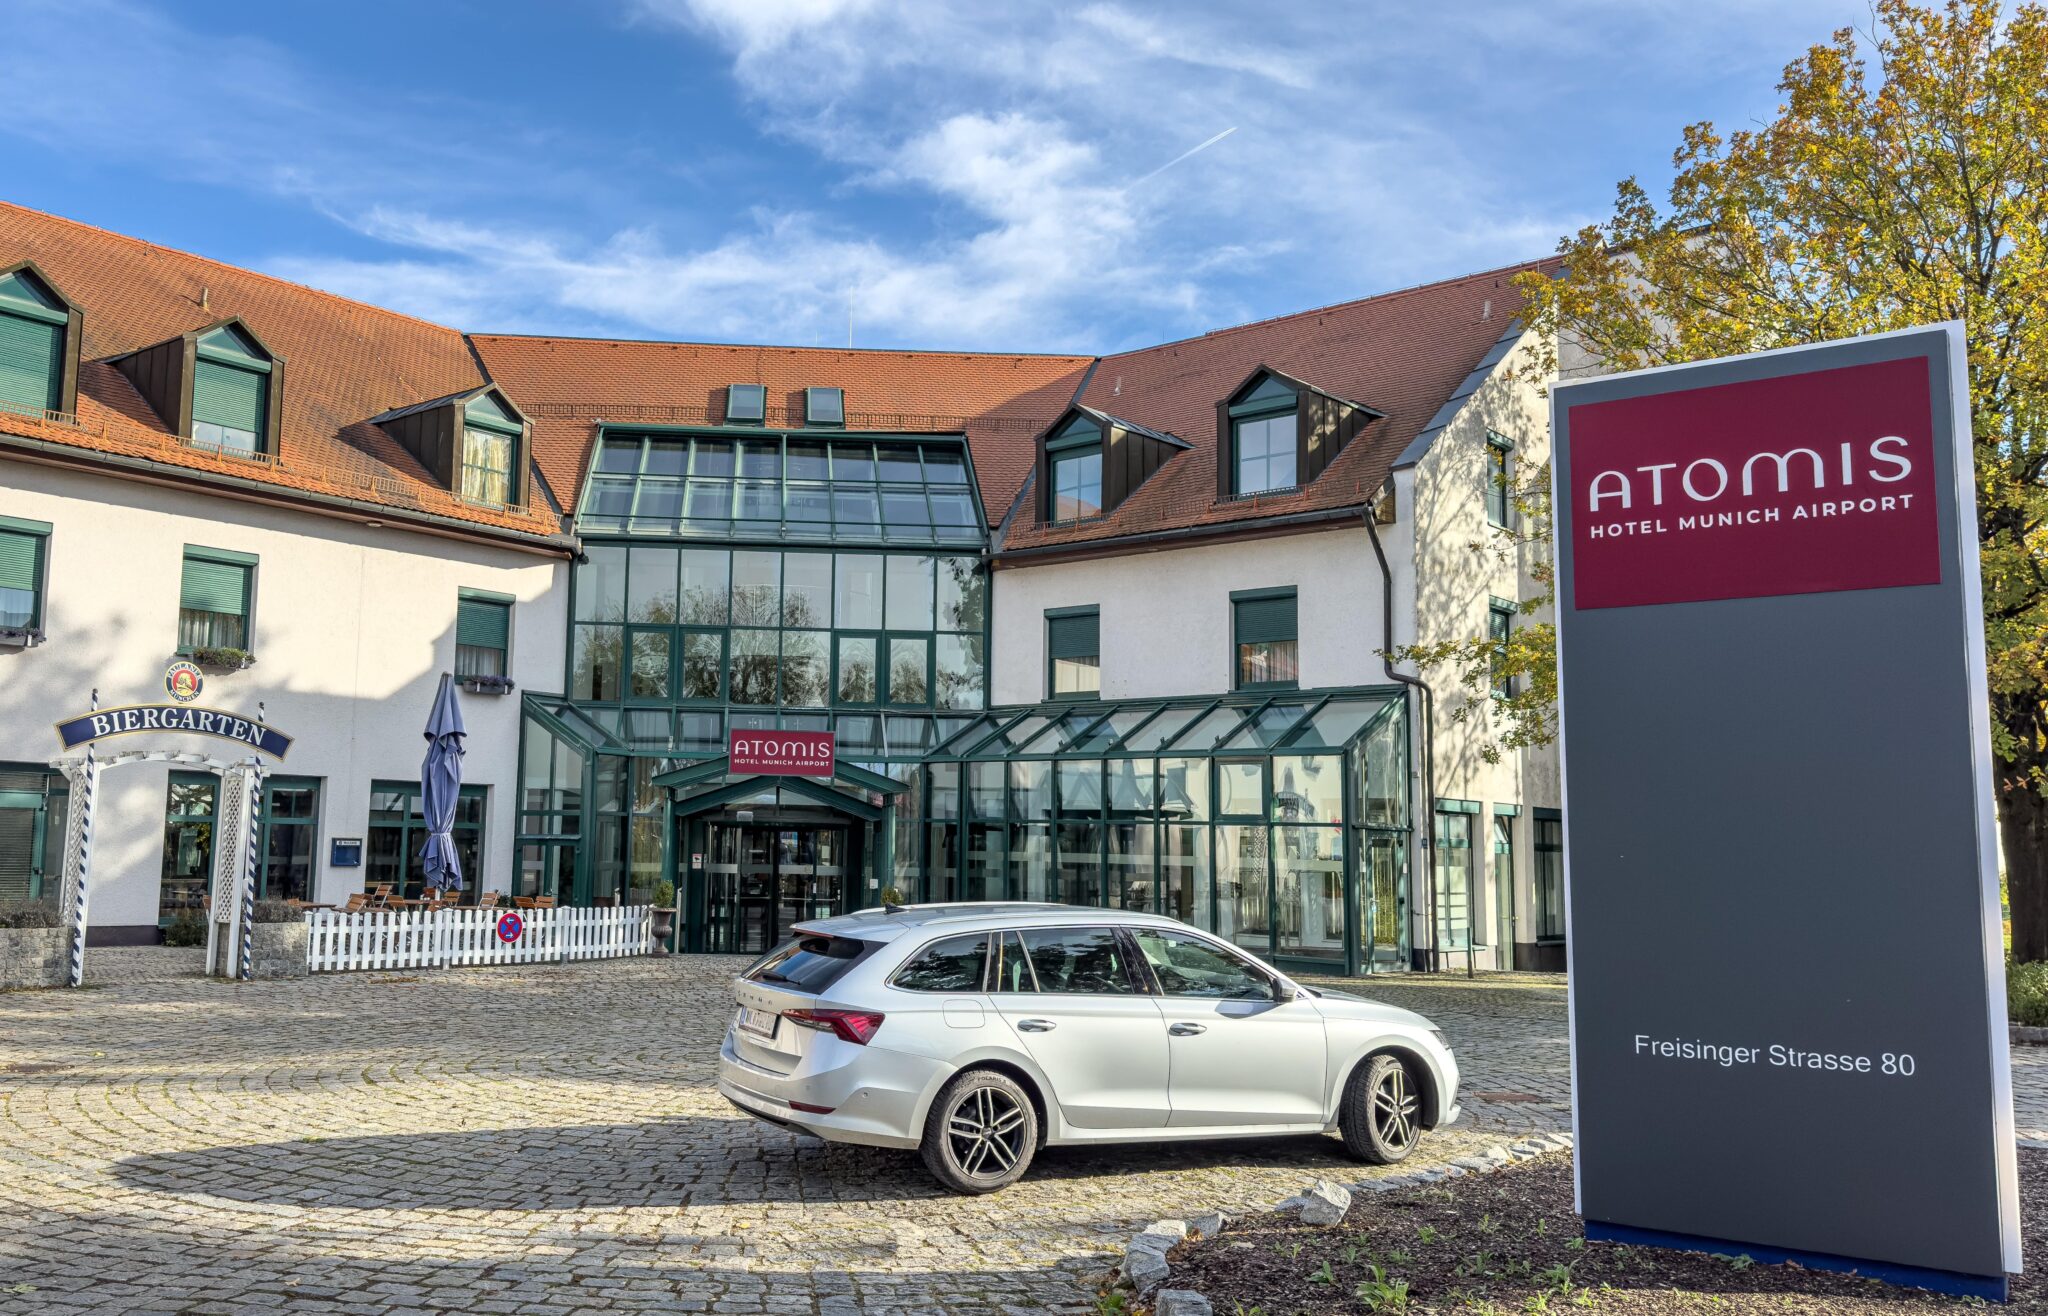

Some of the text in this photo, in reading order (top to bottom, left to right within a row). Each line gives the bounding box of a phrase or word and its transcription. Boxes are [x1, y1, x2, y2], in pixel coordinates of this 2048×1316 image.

[1589, 436, 1912, 512] ATOMIS
[1590, 494, 1914, 538] HOTEL MUNICH AIRPORT
[90, 708, 266, 745] BIERGARTEN
[735, 740, 830, 757] ATOMIS
[1635, 1034, 1915, 1076] Freisinger Strasse 80
